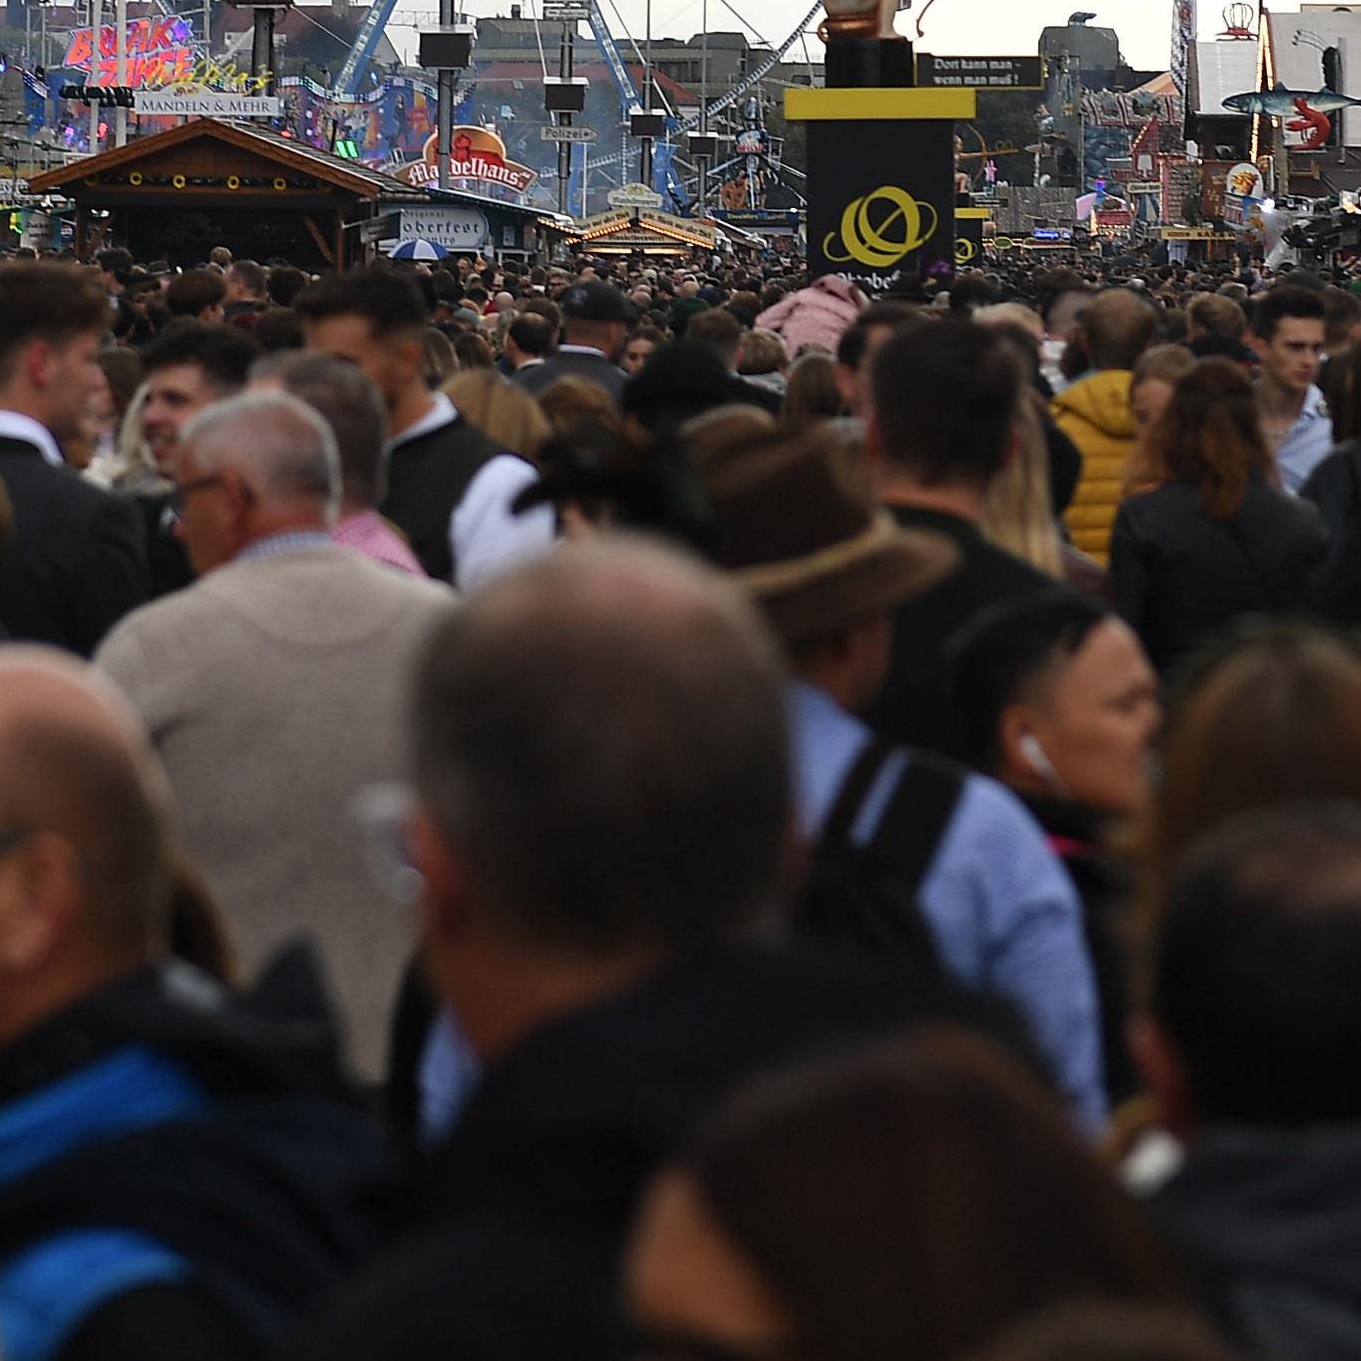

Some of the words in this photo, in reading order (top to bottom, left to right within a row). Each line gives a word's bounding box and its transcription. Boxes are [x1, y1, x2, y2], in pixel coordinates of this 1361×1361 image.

[934, 58, 959, 70] Dort
[961, 59, 988, 70] kann
[989, 60, 1013, 70] man
[934, 76, 962, 85] wenn
[963, 76, 988, 85] man
[141, 100, 210, 113] MANDELN
[213, 100, 224, 112] &
[229, 100, 271, 113] MEHR
[545, 128, 583, 139] Polizei
[408, 157, 520, 186] Madelhans
[403, 221, 479, 233] oberfest
